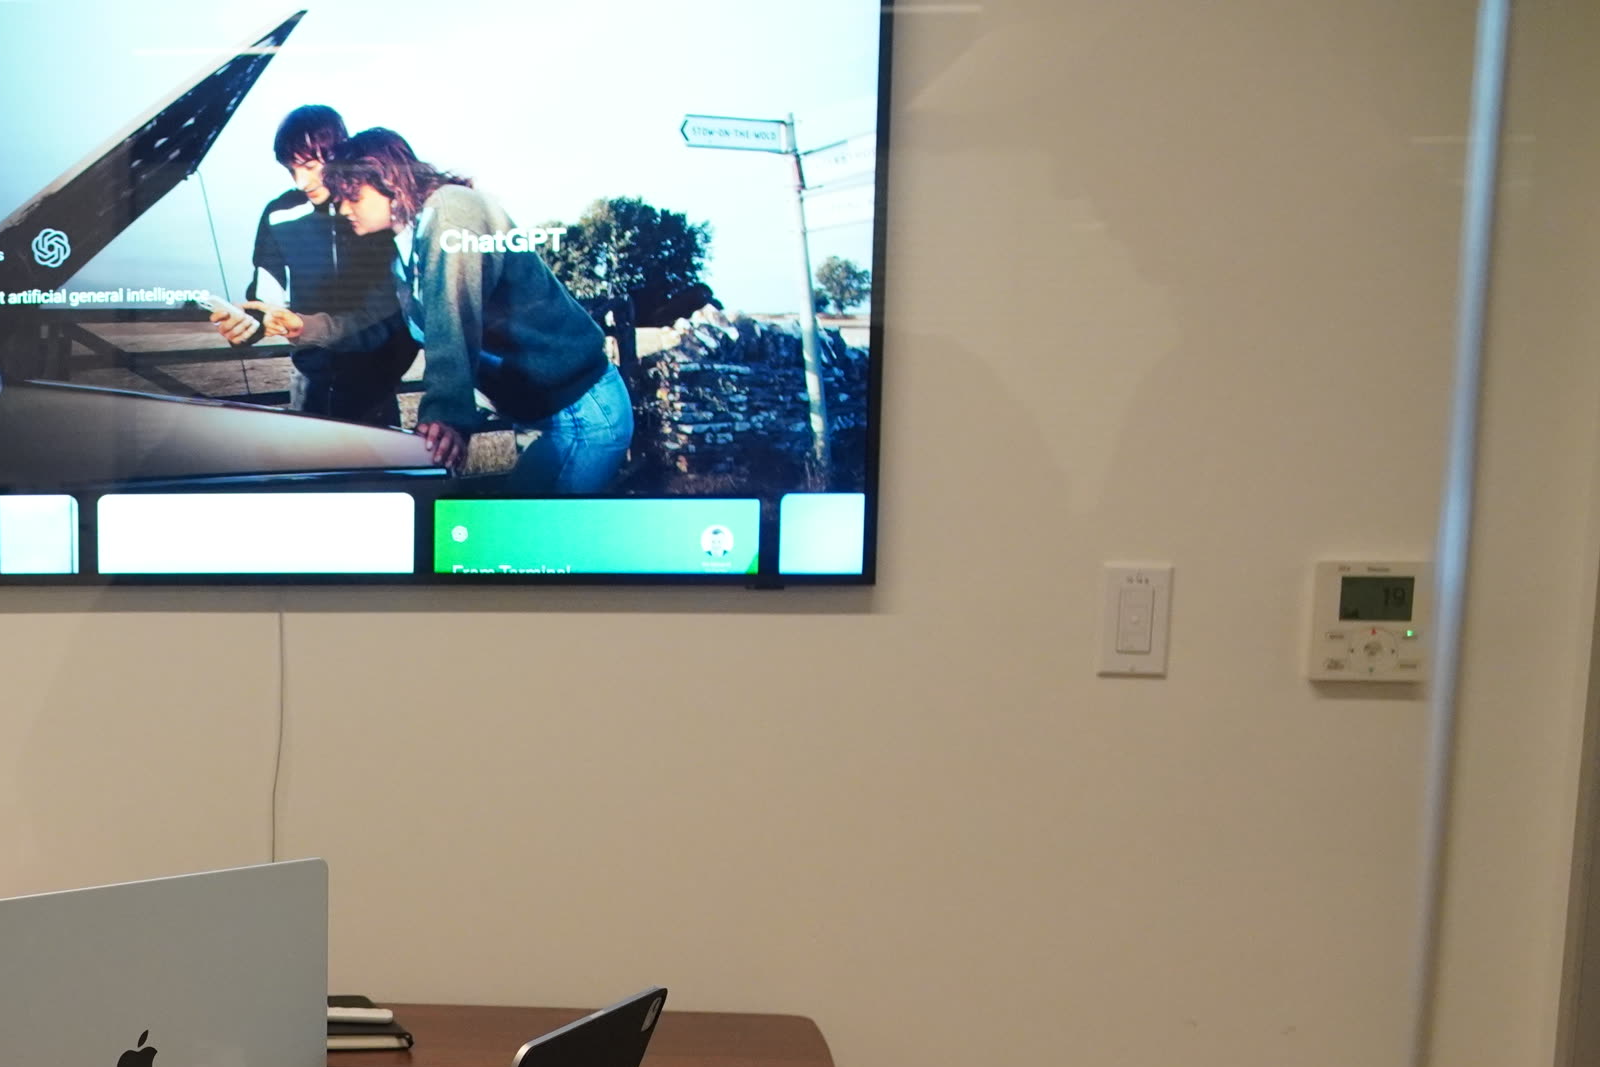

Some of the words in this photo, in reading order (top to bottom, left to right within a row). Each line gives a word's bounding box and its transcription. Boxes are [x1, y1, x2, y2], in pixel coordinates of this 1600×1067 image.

[439, 227, 568, 254] ChatGPT
[8, 288, 67, 304] artificial
[69, 287, 123, 306] general
[126, 287, 211, 305] intelligence
